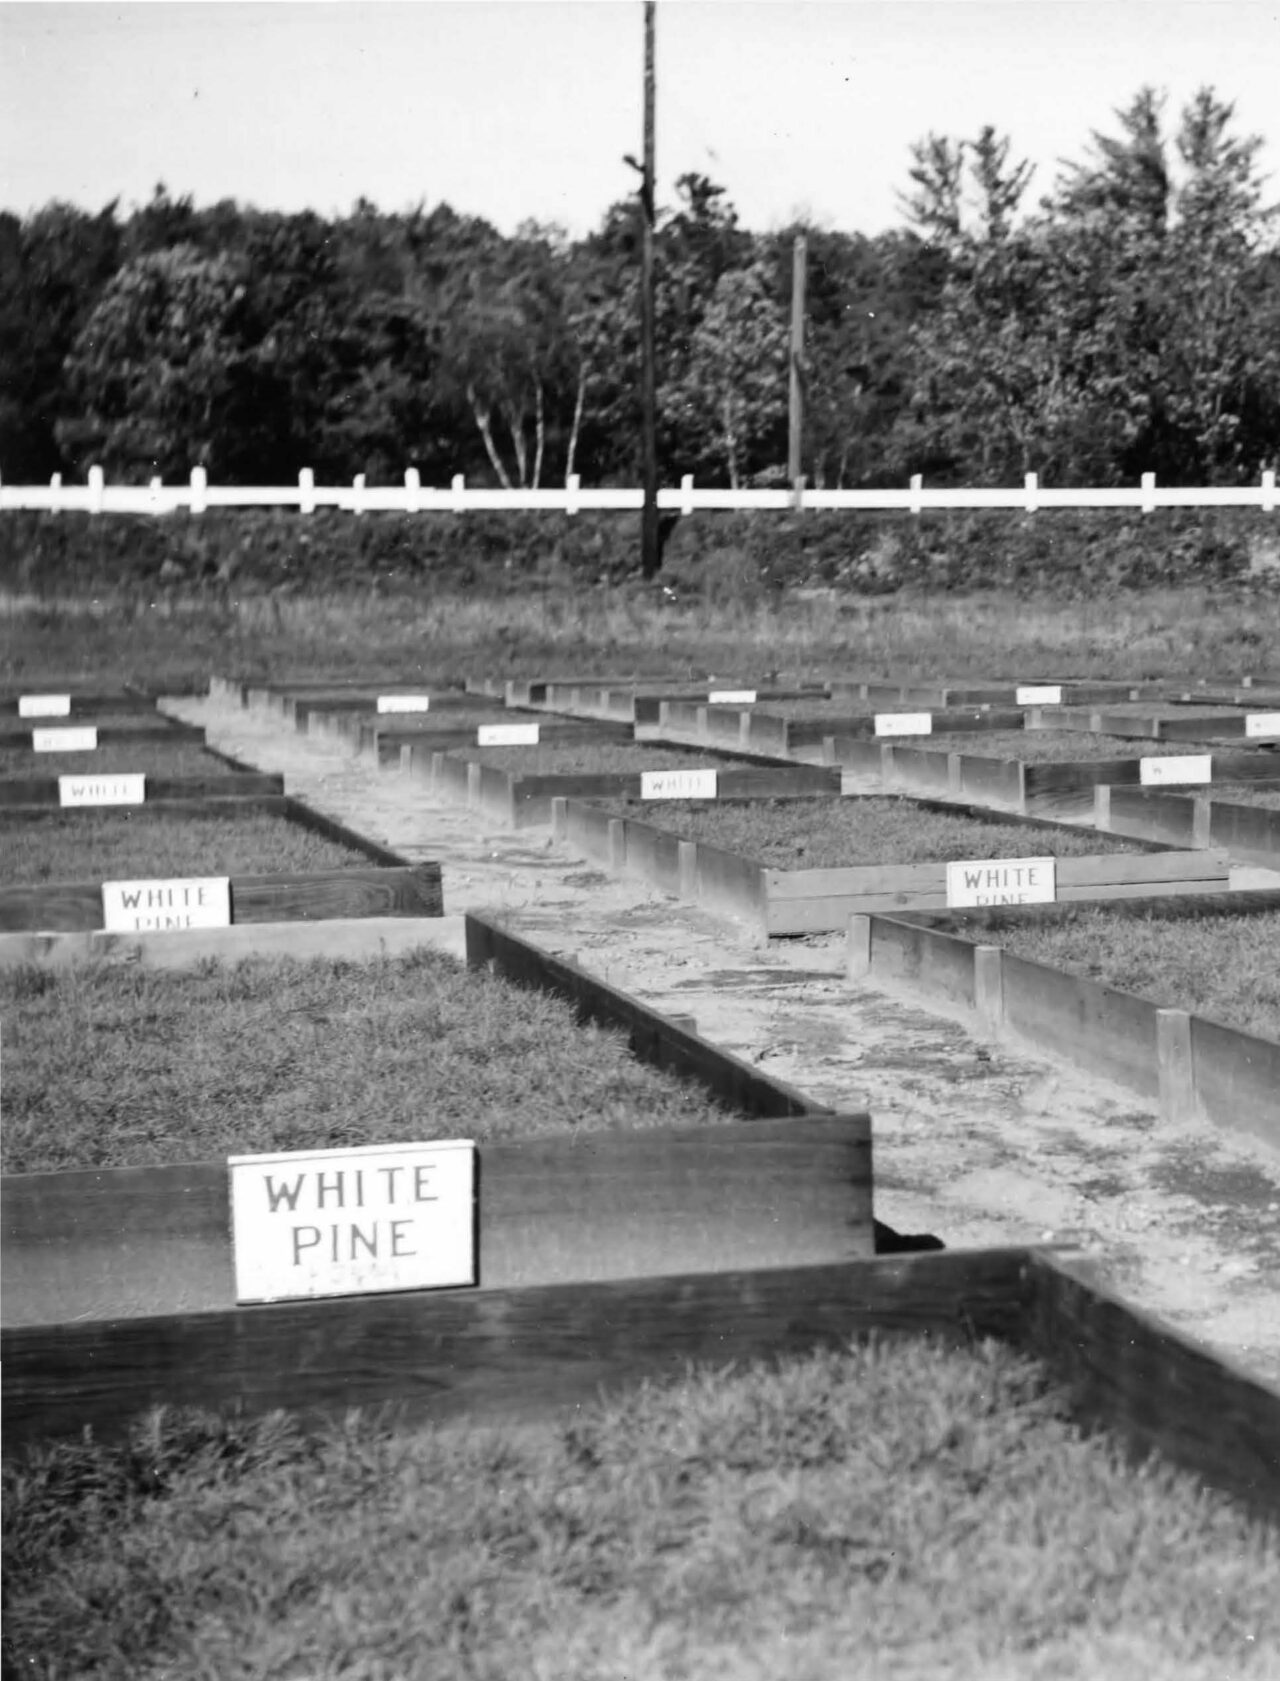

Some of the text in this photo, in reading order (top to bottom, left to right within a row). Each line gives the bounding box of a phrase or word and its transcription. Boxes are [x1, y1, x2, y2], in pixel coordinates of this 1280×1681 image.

[964, 867, 1039, 889] WHITE
[120, 887, 206, 908] WHITE
[263, 1163, 440, 1213] WHITE
[291, 1218, 418, 1267] PINE
